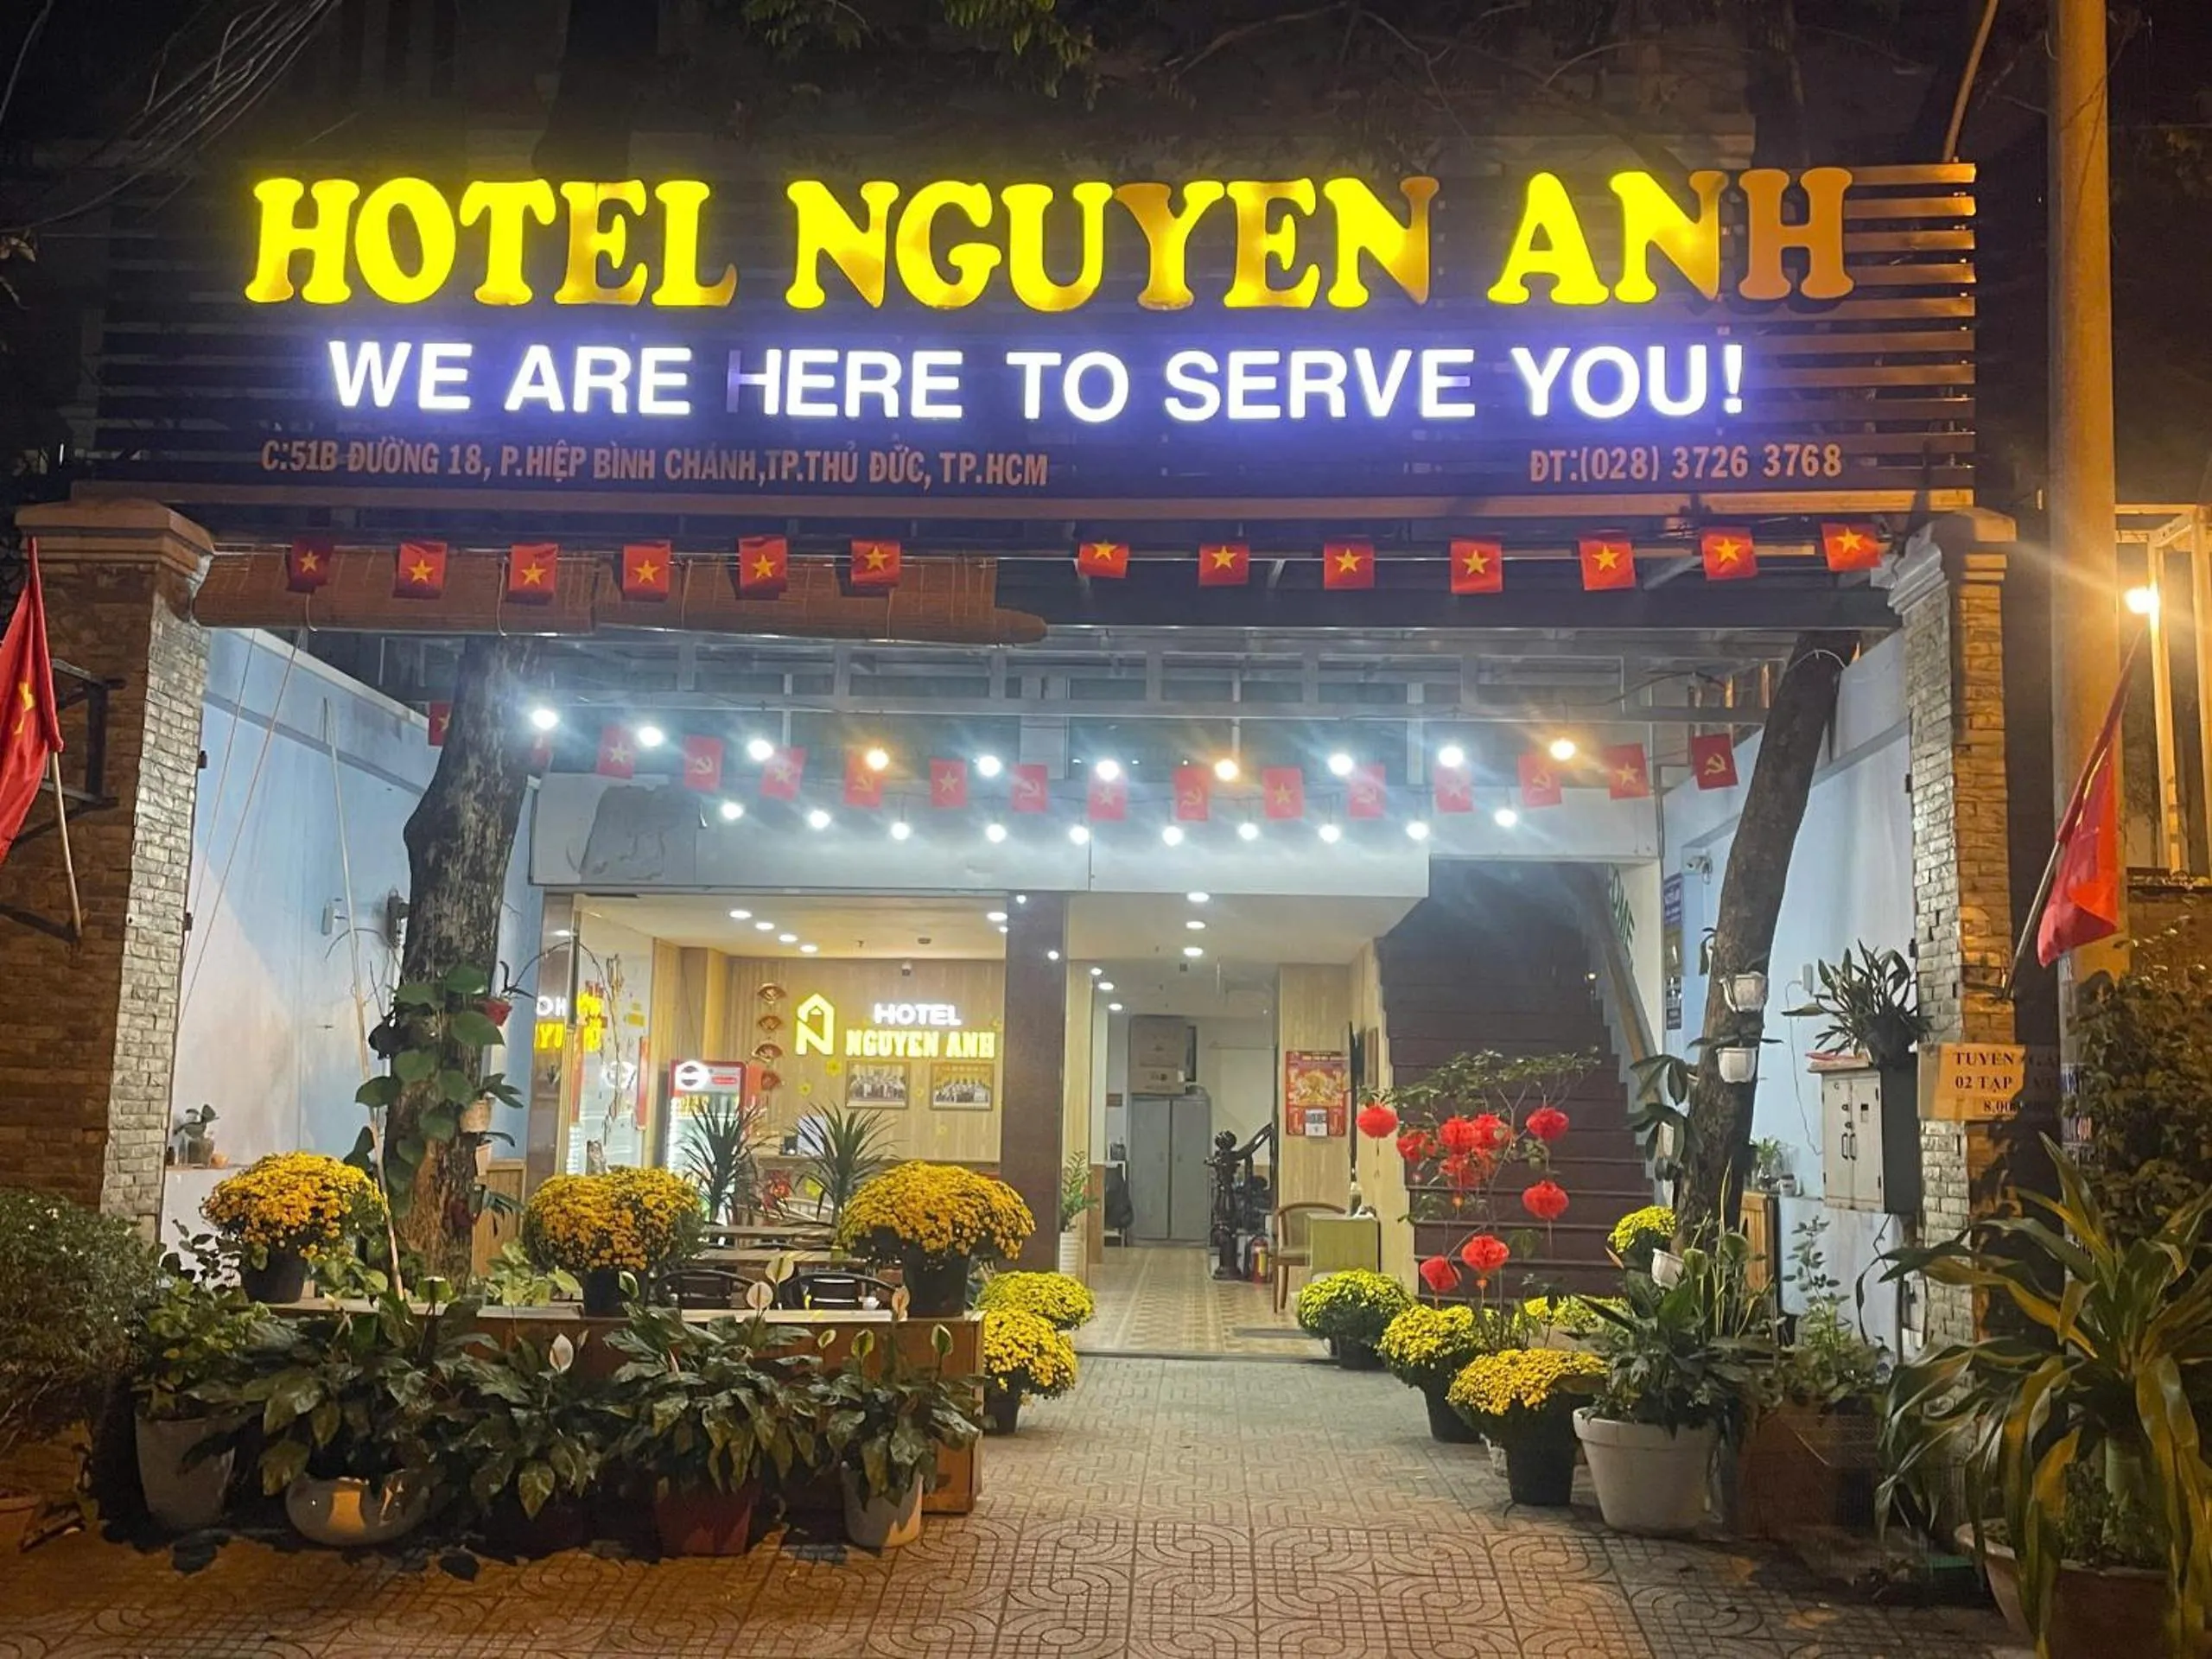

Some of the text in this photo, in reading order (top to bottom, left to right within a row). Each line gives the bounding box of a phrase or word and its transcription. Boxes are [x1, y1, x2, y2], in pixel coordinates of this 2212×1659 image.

[245, 168, 1855, 312] HOTEL NGUYEN ANH
[328, 340, 1744, 423] WE ARE HERE TO SERVE YOU!
[347, 436, 439, 475] ĐƯỜNG
[448, 443, 491, 481] 18,
[500, 438, 586, 483] P.HIỆP
[594, 442, 655, 480] BÌNH
[939, 451, 1047, 486] TP.HCM
[1672, 445, 1749, 479] 3726
[1764, 443, 1842, 477] 3768
[874, 1002, 962, 1026] HOTEL
[845, 1029, 995, 1058] NGUYEN ANH
[1955, 1076, 1973, 1089] 02
